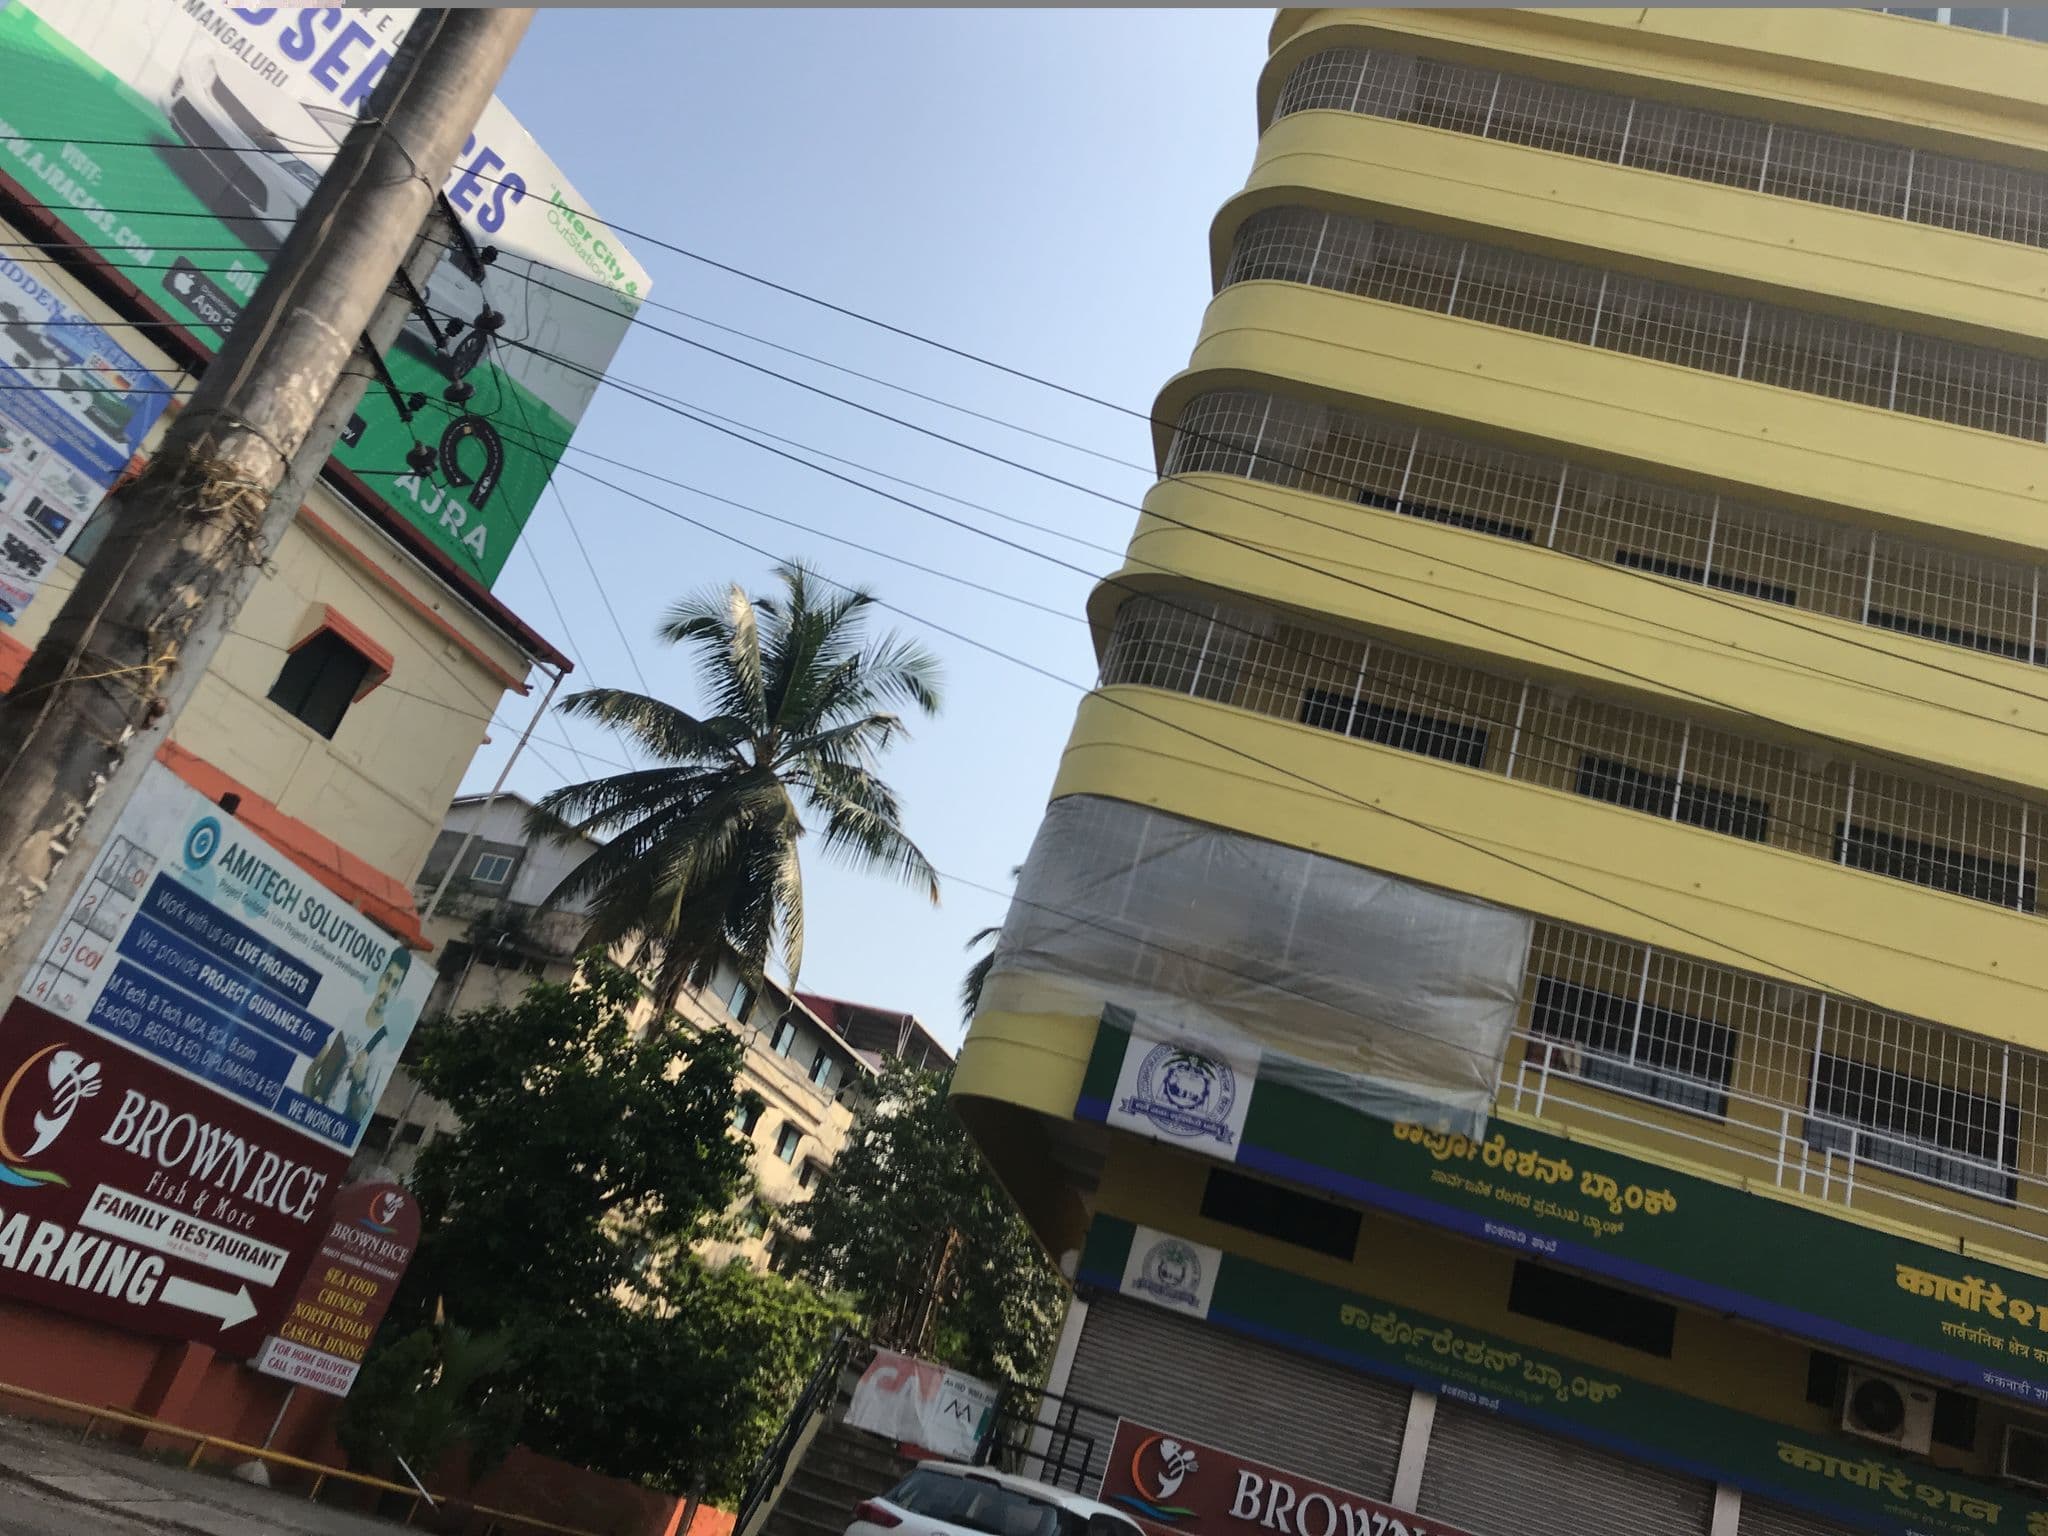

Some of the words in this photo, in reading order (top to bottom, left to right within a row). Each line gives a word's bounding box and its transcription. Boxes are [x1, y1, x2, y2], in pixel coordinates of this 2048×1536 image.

[183, 5, 289, 88] MANGALURU
[592, 236, 624, 283] City
[194, 292, 220, 328] App
[393, 470, 488, 561] AJRA
[218, 842, 301, 914] AMITECH
[300, 900, 387, 971] SOLUTIONS
[58, 936, 71, 956] 3
[156, 891, 186, 926] Work
[184, 906, 208, 934] with
[234, 938, 259, 967] LIVE
[256, 947, 309, 993] PROJECTS
[136, 929, 155, 954] We
[152, 940, 199, 979] provide
[199, 963, 250, 1012] PROJECT
[247, 988, 303, 1035] GUIDANCE
[300, 1020, 316, 1043] for
[287, 1098, 305, 1121] WE
[301, 1104, 333, 1133] WORK
[331, 1119, 349, 1142] ON
[101, 1089, 263, 1192] BROWN
[241, 1150, 329, 1224] RICE
[144, 1170, 189, 1205] Fish
[211, 1199, 257, 1231] More
[1579, 1168, 1679, 1217] ಬ್ಯಾಂಕ್
[95, 1189, 169, 1240] FAMILY
[169, 1217, 283, 1272] RESTAURANT
[330, 1221, 382, 1255] BROWN
[378, 1237, 411, 1264] RICE
[0, 1206, 166, 1307] ARKING
[317, 1287, 366, 1318] CHINESE
[324, 1266, 348, 1288] SEA
[346, 1274, 378, 1298] FOOD
[280, 1321, 323, 1349] CASUAL
[319, 1334, 366, 1361] DINING
[292, 1302, 334, 1331] NORTH
[330, 1315, 373, 1340] INDIAN
[268, 1356, 290, 1375] CALL
[273, 1341, 291, 1358] FOR
[290, 1346, 317, 1366] HOME
[316, 1355, 354, 1378] DELIVERY
